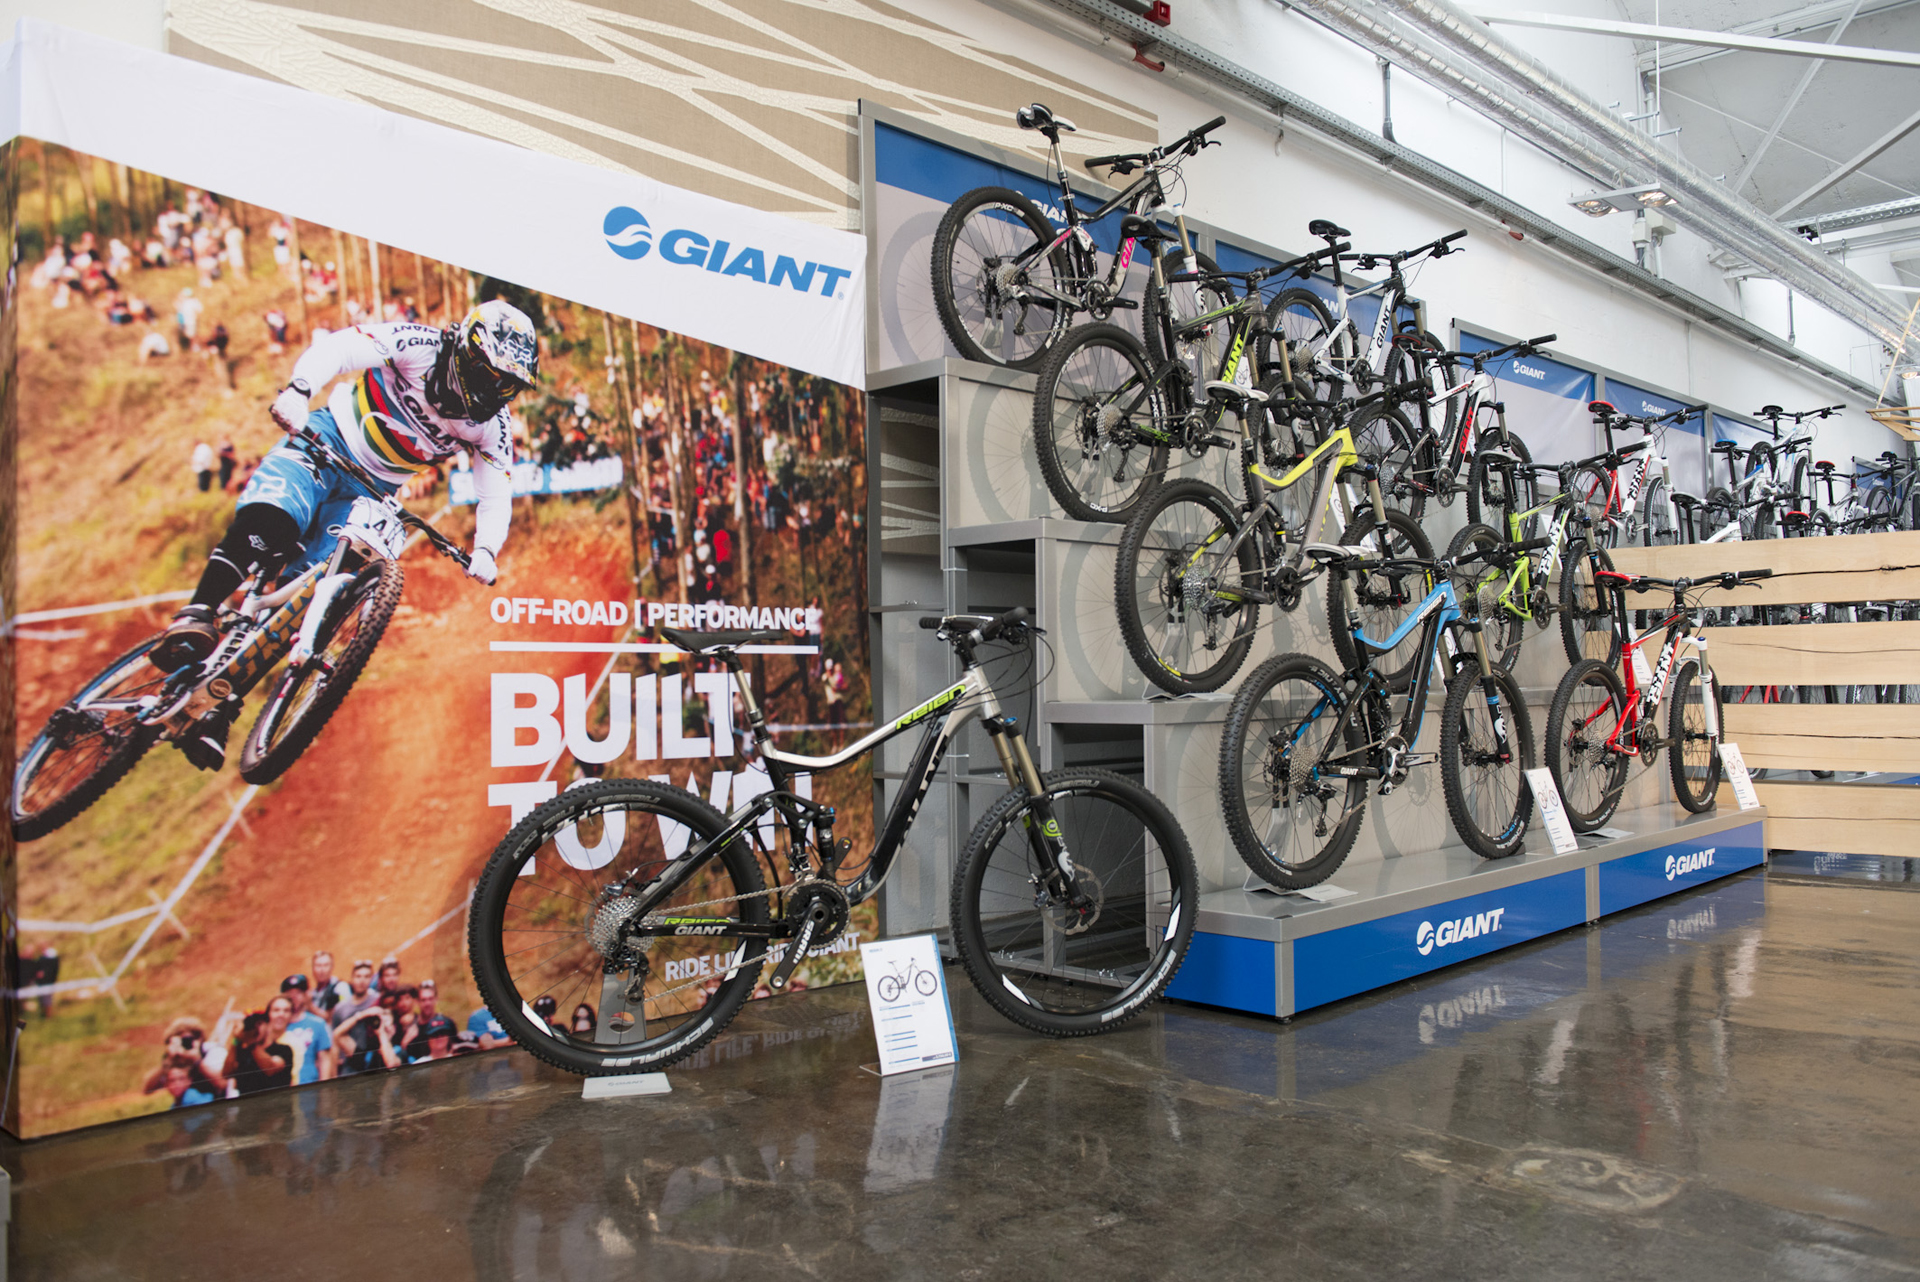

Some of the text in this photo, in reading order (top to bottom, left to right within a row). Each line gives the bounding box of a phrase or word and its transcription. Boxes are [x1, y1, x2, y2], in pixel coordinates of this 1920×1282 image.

[658, 228, 852, 298] GIANT
[1376, 305, 1391, 349] GIANT
[1520, 364, 1546, 380] GIANT
[1647, 403, 1667, 416] GIANT
[1459, 406, 1474, 455] GIANT
[490, 597, 629, 627] OFF-ROAD
[647, 602, 817, 631] PERFORMANCE
[490, 672, 751, 768] BUILT
[1340, 767, 1359, 776] GIANT
[488, 776, 626, 877] TO
[1675, 847, 1715, 876] GIANT
[674, 925, 727, 937] GIANT
[793, 920, 815, 964] SRAM
[1435, 907, 1505, 947] GIANT
[665, 954, 711, 982] RIDE
